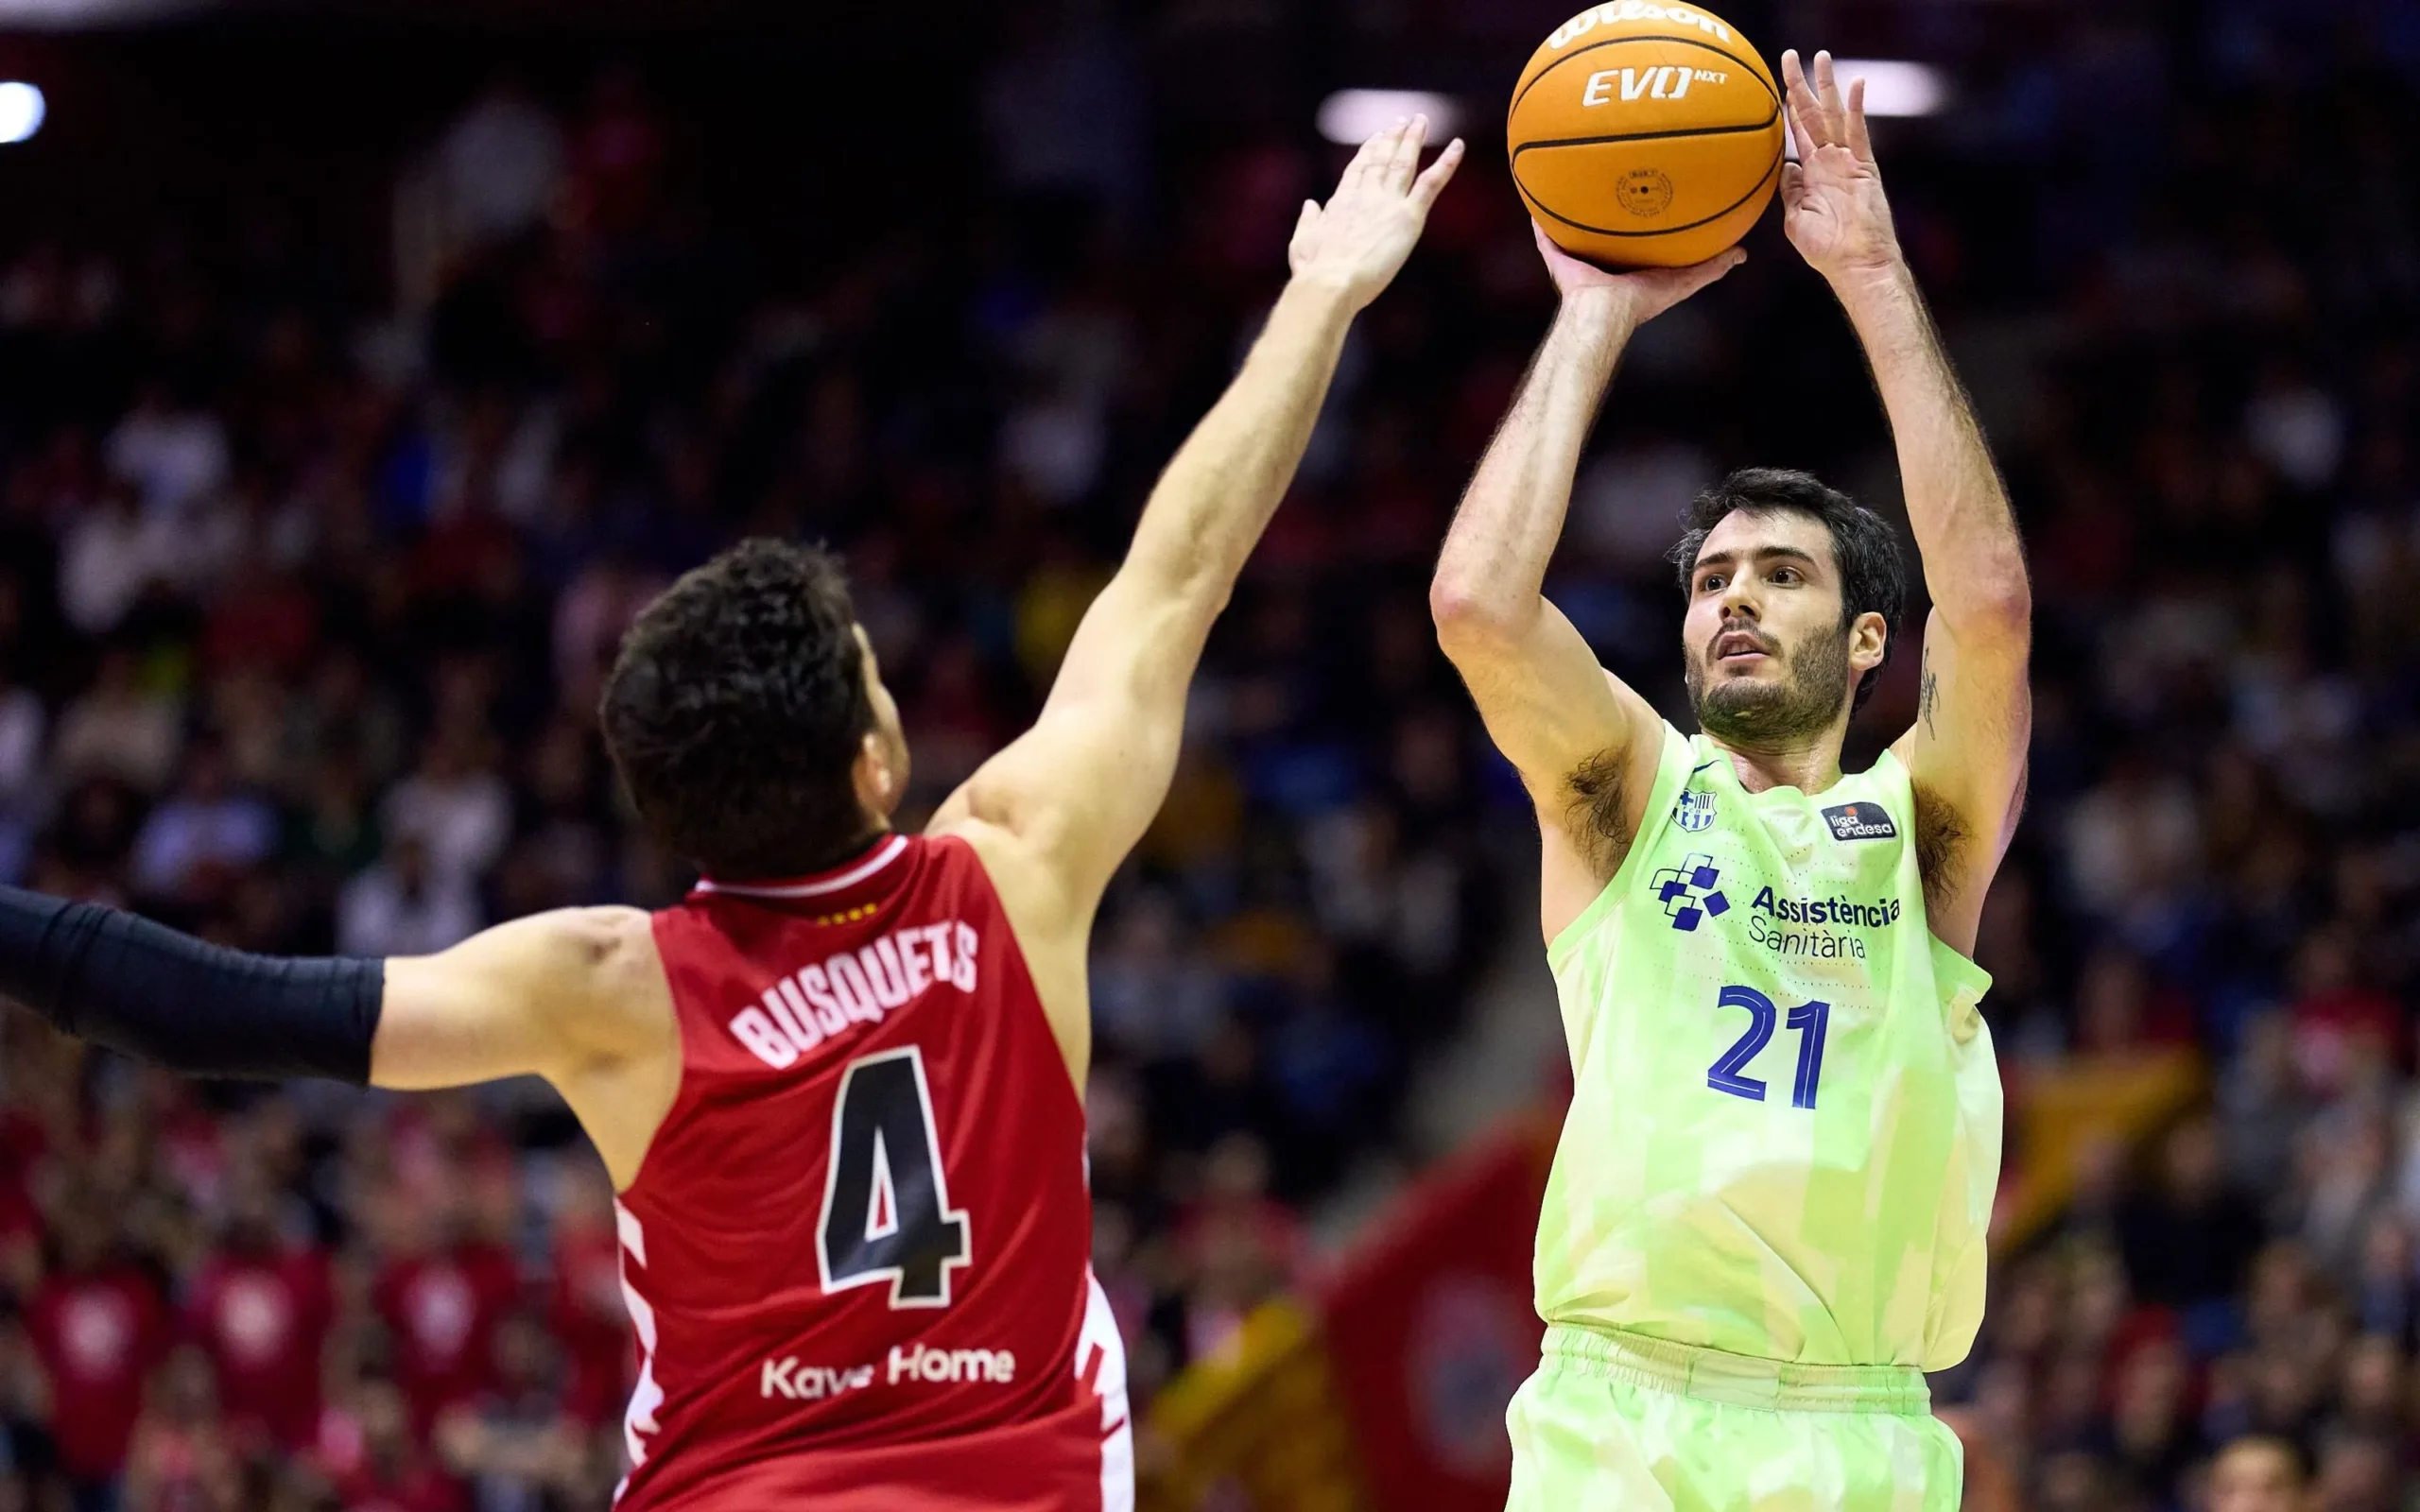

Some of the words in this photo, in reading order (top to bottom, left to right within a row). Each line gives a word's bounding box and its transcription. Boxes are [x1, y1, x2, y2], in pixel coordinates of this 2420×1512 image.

[1582, 66, 1692, 107] EVO
[1694, 69, 1728, 84] NXT
[1829, 815, 1859, 828] liga
[1836, 823, 1893, 838] endesa
[1751, 885, 1900, 928] Assistència
[1749, 915, 1866, 960] Sanitària
[728, 919, 978, 1070] BUSQUETS
[1707, 985, 1831, 1109] 21
[815, 1043, 973, 1311] 4
[887, 1342, 1016, 1385] Home
